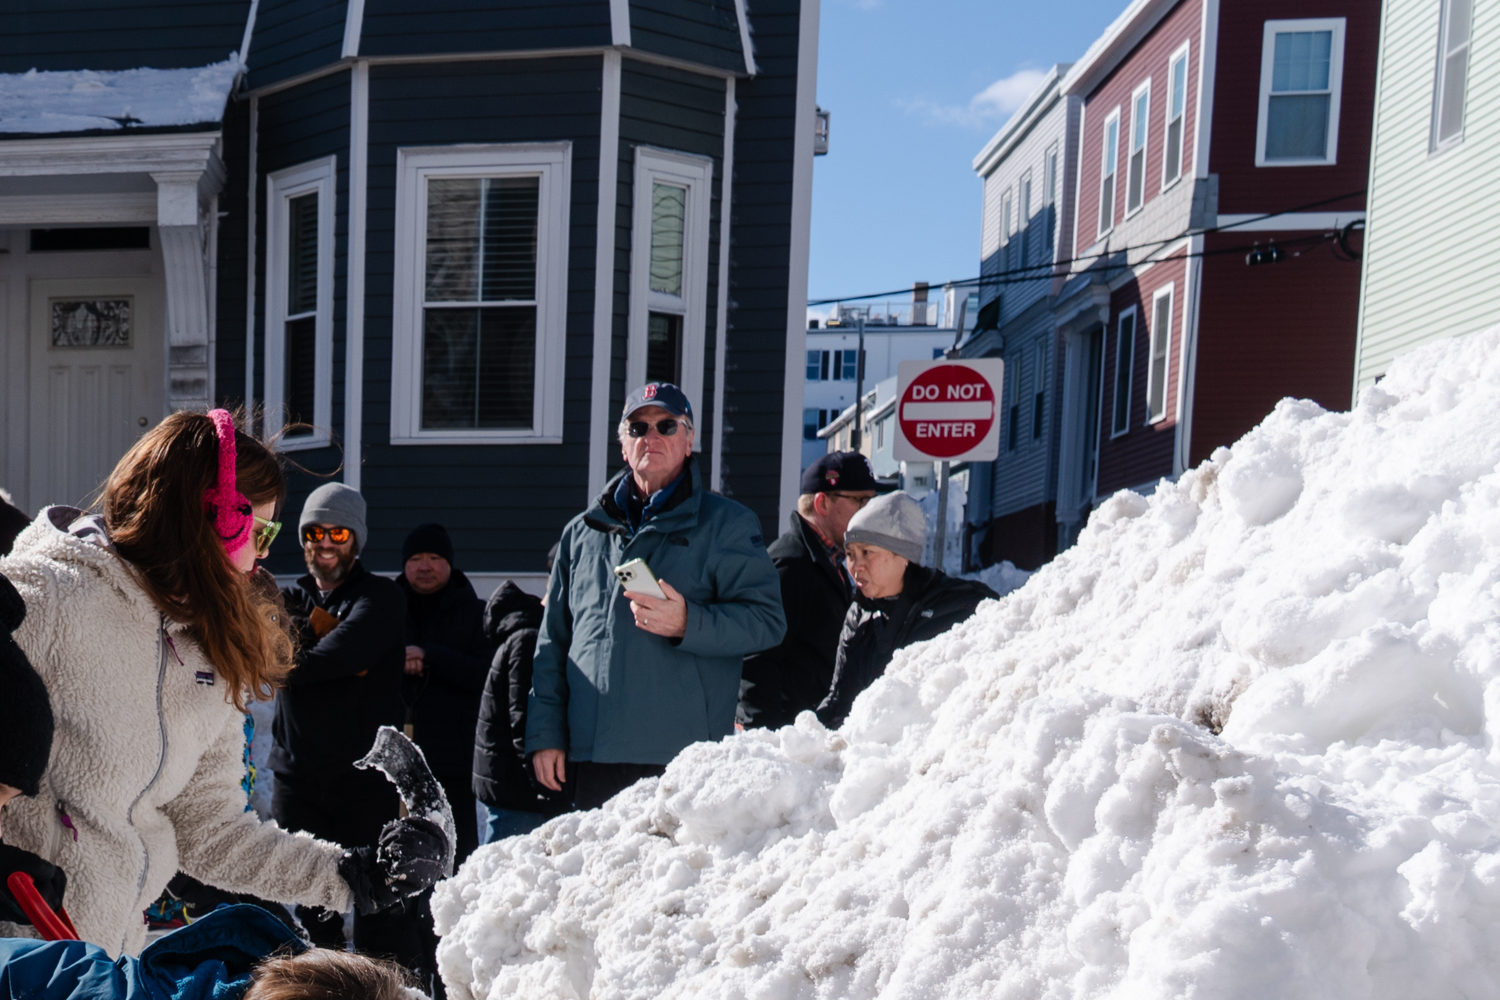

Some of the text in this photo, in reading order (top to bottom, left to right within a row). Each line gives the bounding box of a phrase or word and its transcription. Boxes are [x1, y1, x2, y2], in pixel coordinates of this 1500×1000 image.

[642, 384, 657, 400] B
[912, 383, 985, 400] DO NOT
[916, 422, 976, 438] ENTER
